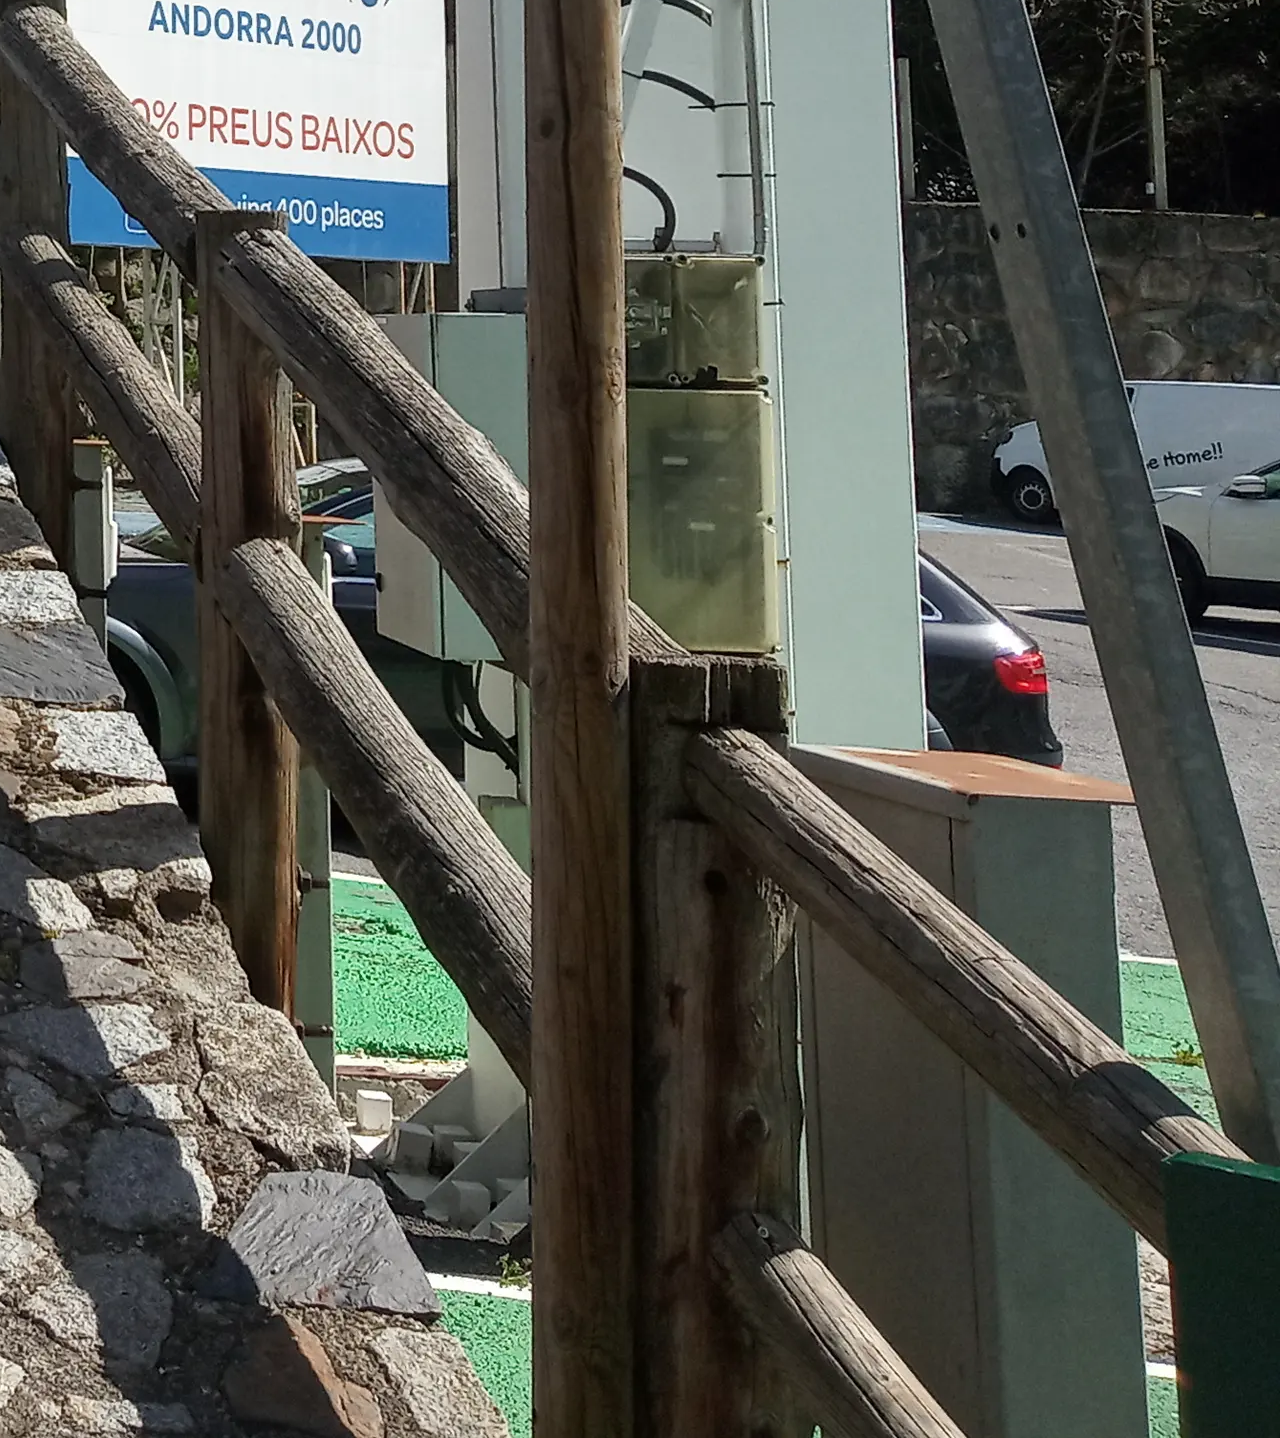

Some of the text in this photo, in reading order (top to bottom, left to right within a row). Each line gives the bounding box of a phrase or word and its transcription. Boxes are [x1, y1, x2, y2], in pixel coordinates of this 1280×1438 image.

[148, 0, 362, 55] ANDORRA 2000
[187, 102, 294, 150] PREUS
[301, 113, 415, 160] BAIXOS
[320, 199, 385, 233] places
